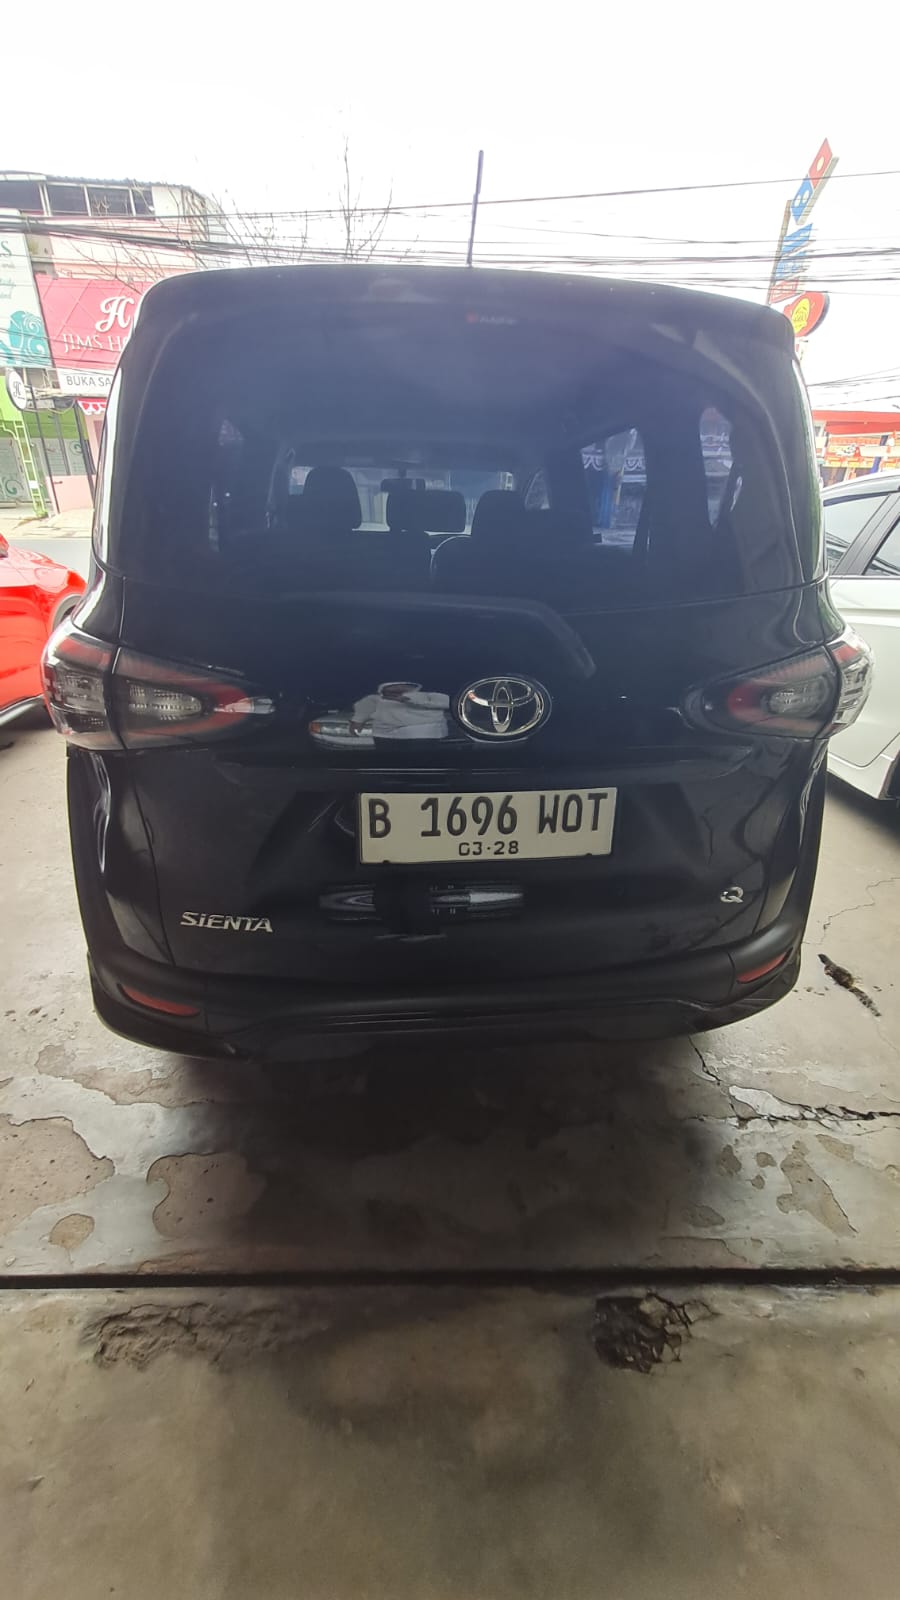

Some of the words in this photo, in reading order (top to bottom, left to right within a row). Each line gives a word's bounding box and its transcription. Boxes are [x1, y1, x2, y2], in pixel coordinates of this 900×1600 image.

[62, 333, 103, 353] JIMS
[66, 375, 96, 387] BUKA
[368, 797, 391, 839] B
[420, 794, 518, 838] 1696
[537, 792, 608, 834] WOT
[720, 886, 744, 904] Q
